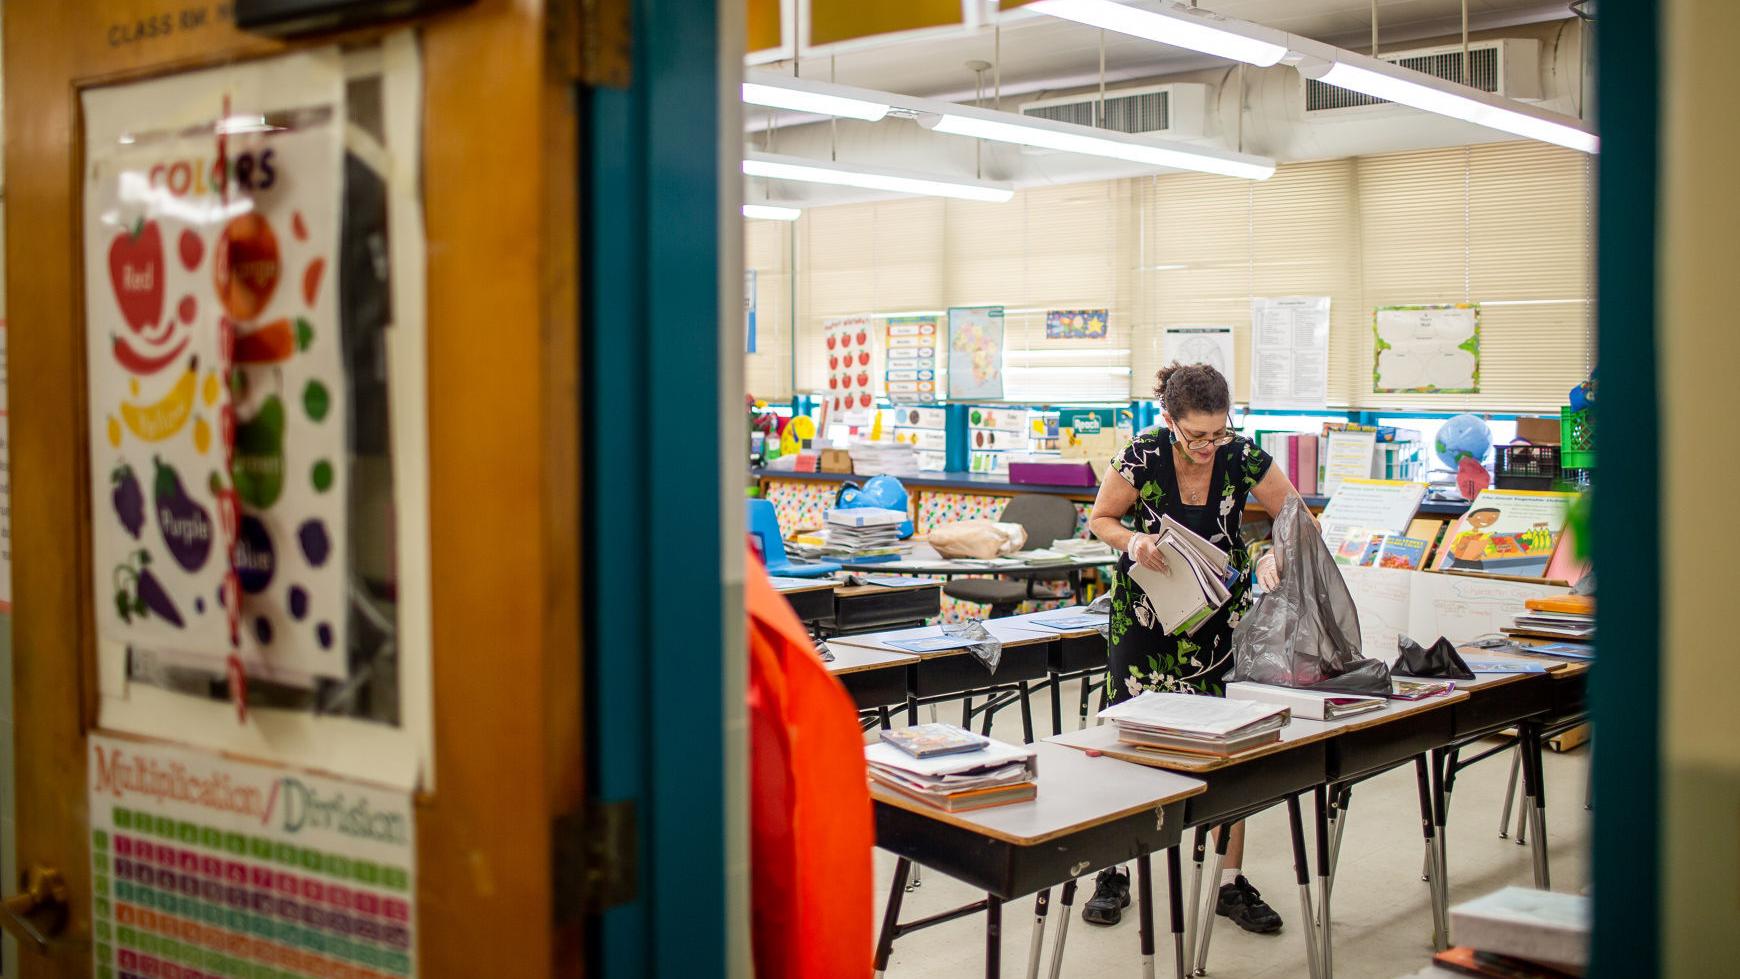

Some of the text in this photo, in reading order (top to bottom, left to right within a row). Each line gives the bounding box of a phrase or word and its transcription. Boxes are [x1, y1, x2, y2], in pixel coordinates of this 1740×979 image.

[109, 14, 172, 47] CLASS
[149, 147, 277, 197] COLORS
[122, 261, 154, 291] Red
[1074, 419, 1100, 432] Reach
[160, 507, 209, 546] Purple
